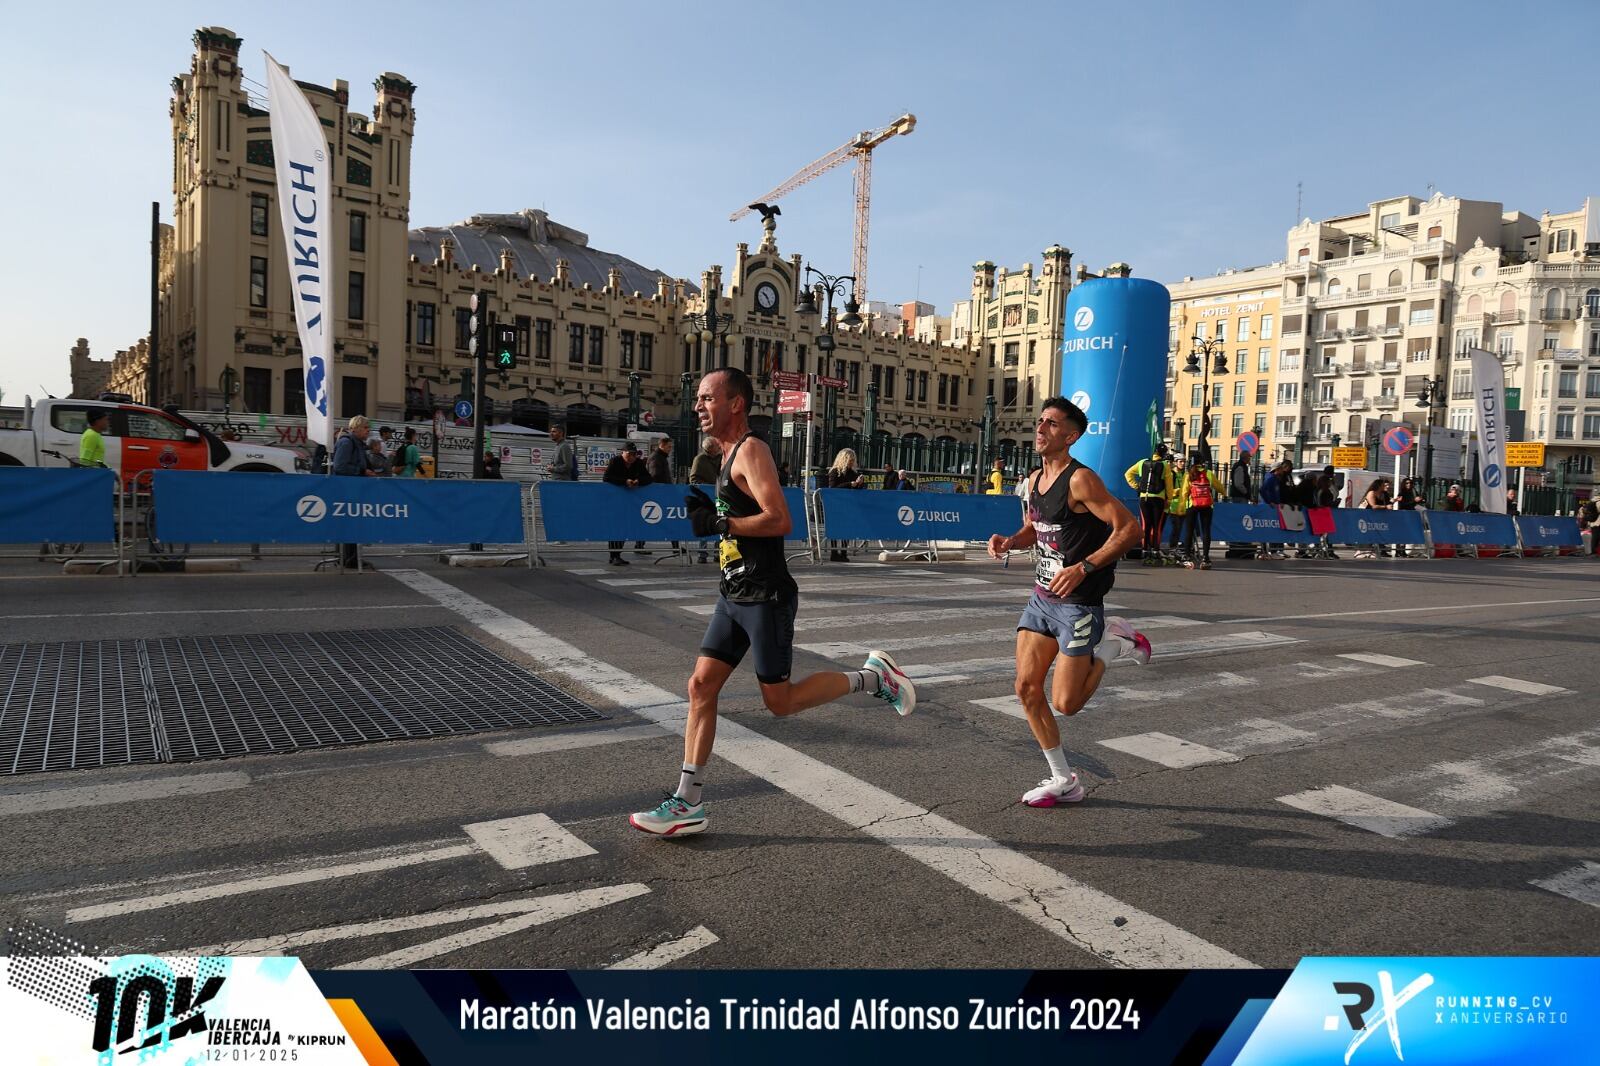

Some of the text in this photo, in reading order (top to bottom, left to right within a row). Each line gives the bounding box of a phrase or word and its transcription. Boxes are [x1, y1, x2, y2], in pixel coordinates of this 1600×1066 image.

[1201, 302, 1265, 317] HOTEL ZENIT
[1064, 336, 1113, 354] ZURICH
[332, 502, 408, 518] ZURICH
[918, 510, 960, 522] ZURICH
[1254, 519, 1280, 528] ZURICH
